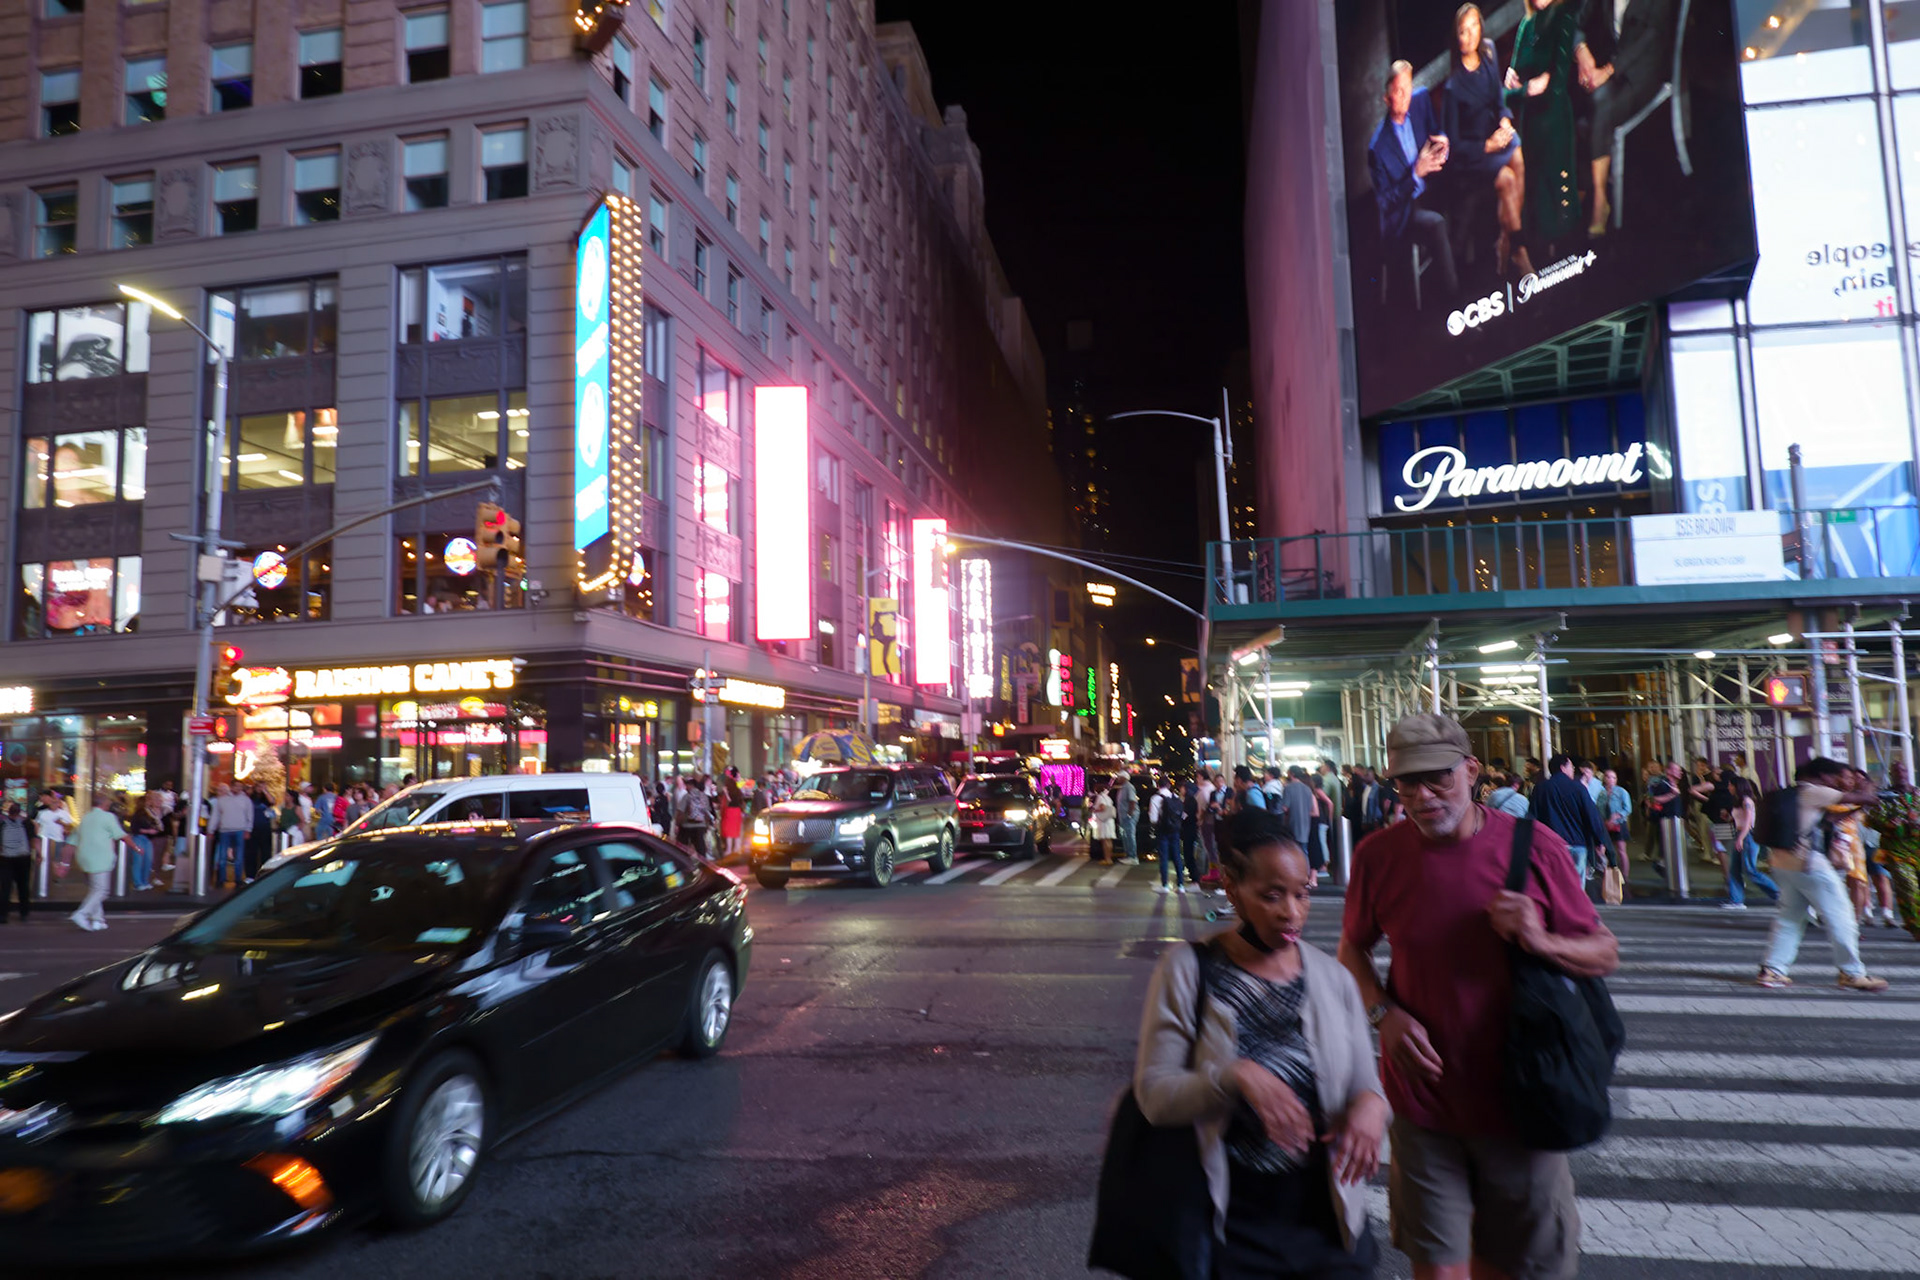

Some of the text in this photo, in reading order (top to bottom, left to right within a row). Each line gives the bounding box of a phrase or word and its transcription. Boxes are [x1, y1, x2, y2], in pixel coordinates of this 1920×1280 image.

[1464, 290, 1506, 328] CBS
[1394, 441, 1643, 512] Paramount
[1696, 481, 1728, 516] BS
[1695, 515, 1736, 535] BROADWAY
[294, 658, 514, 699] RAISING CANE'S
